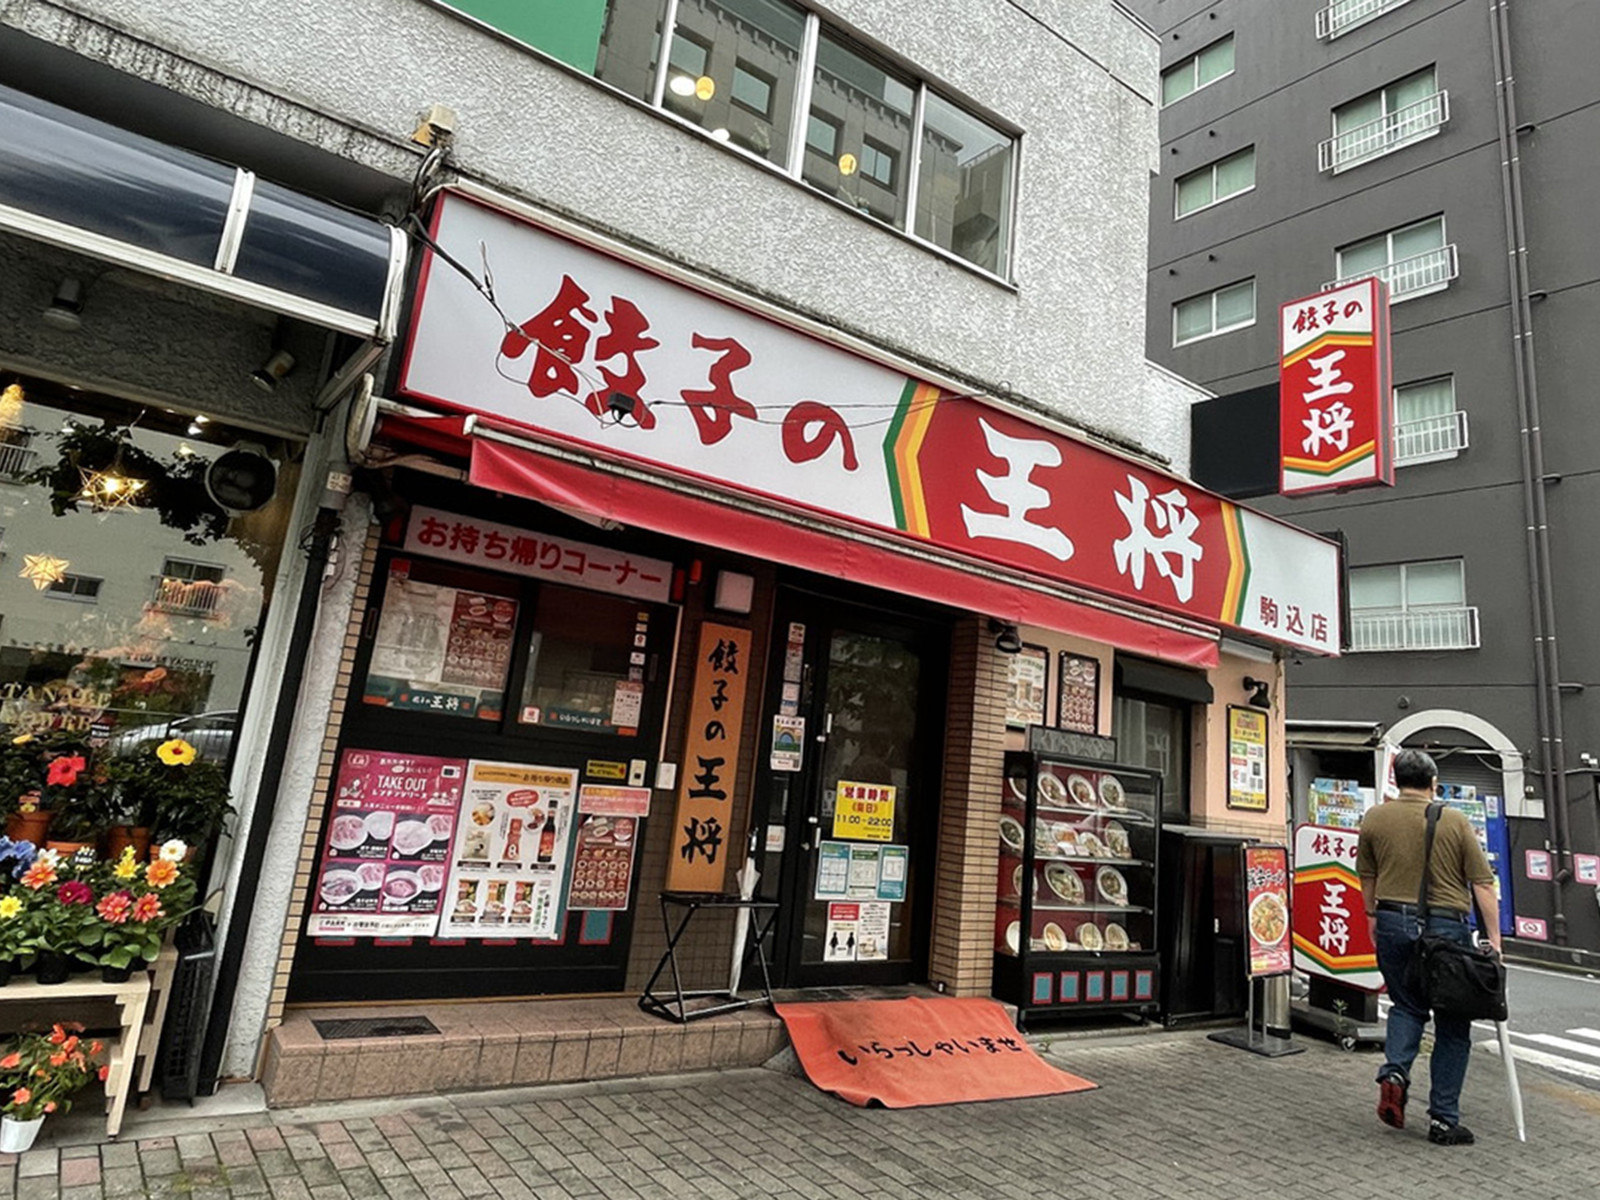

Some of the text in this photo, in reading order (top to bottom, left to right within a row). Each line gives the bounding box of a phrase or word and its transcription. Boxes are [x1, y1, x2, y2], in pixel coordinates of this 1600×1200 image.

[1292, 300, 1363, 334] 餃子の
[1301, 349, 1355, 457] 王将
[501, 274, 1203, 604] 餃子の 王将
[417, 516, 662, 585] お持ち帰りコーナー
[1260, 595, 1328, 643] 駒込店
[377, 775, 427, 792] TAKE OUT
[681, 638, 740, 865] 餃子の王将
[1318, 881, 1351, 955] 王将
[837, 1036, 1023, 1066] いらっしゃいませ
